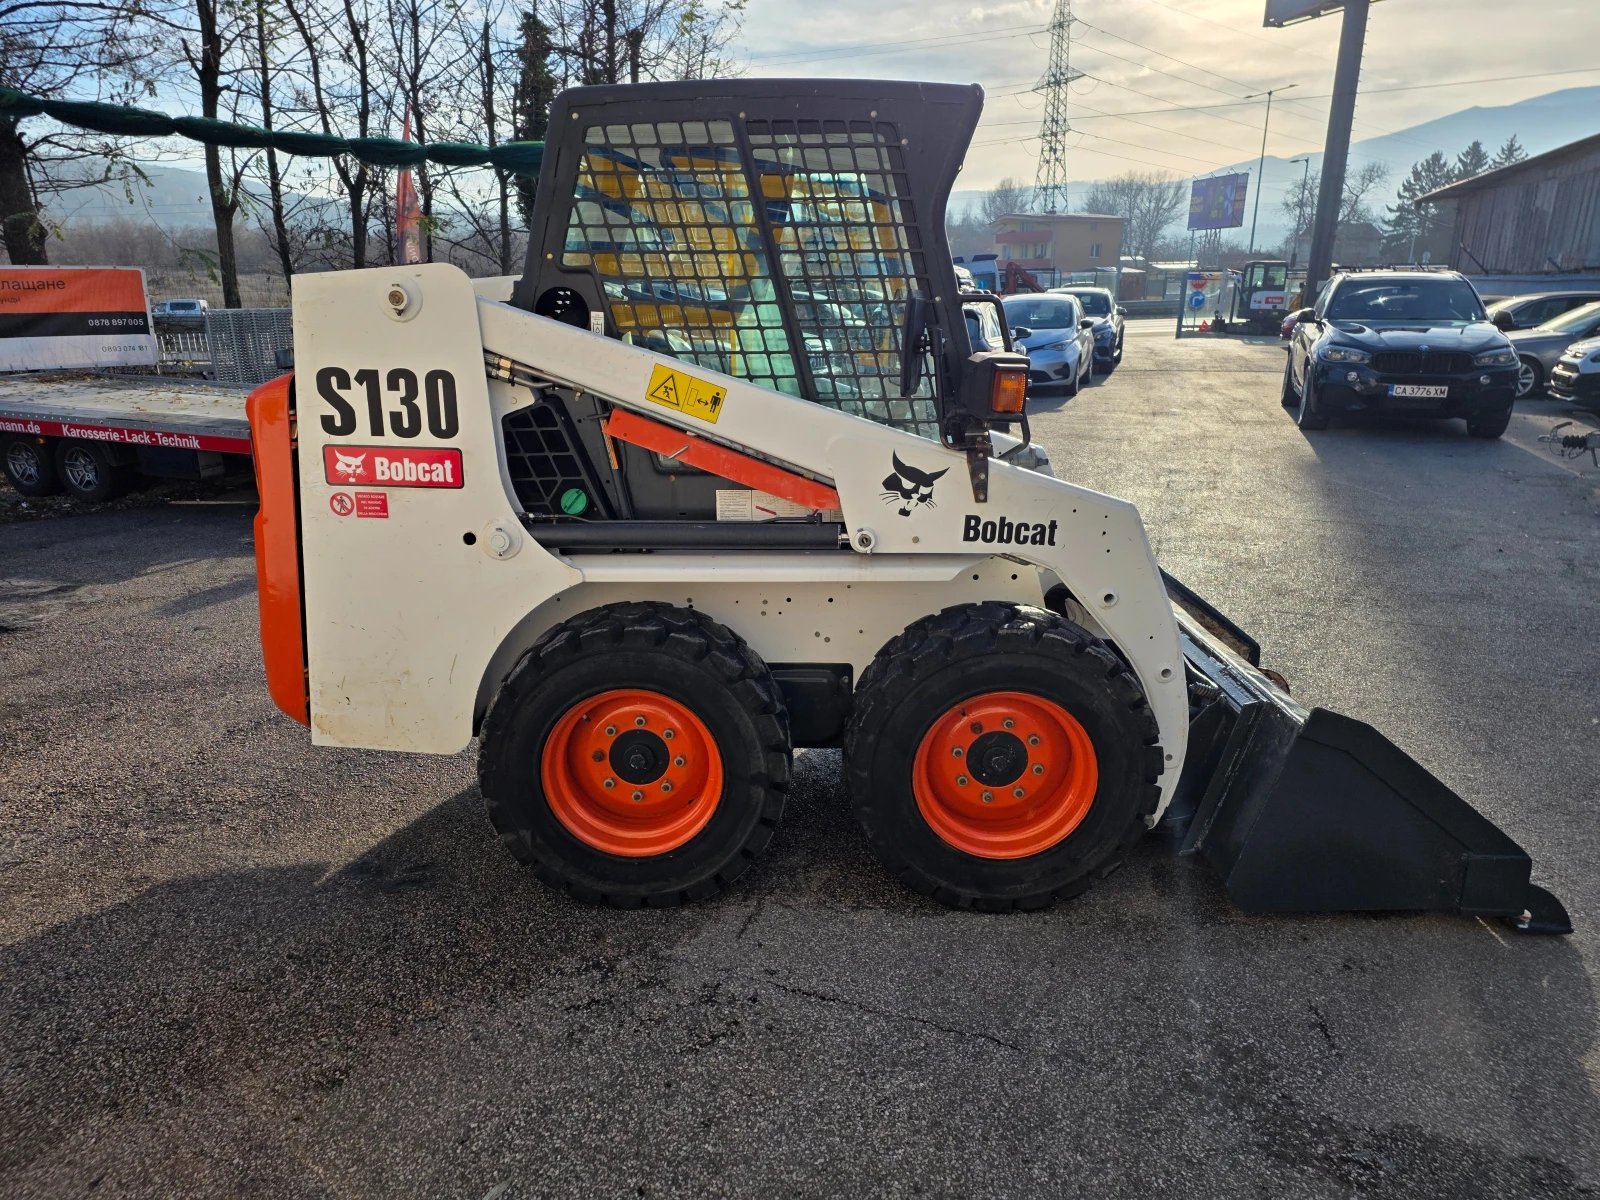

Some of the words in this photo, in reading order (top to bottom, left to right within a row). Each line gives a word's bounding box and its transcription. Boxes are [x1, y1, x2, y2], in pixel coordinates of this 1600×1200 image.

[111, 318, 127, 326] 897
[128, 318, 144, 326] 005
[316, 366, 459, 439] S130
[1394, 386, 1407, 395] CA
[1409, 387, 1432, 396] 3776
[1433, 388, 1446, 396] XM
[374, 456, 454, 483] Bobcat
[962, 514, 1058, 547] Bobcat
